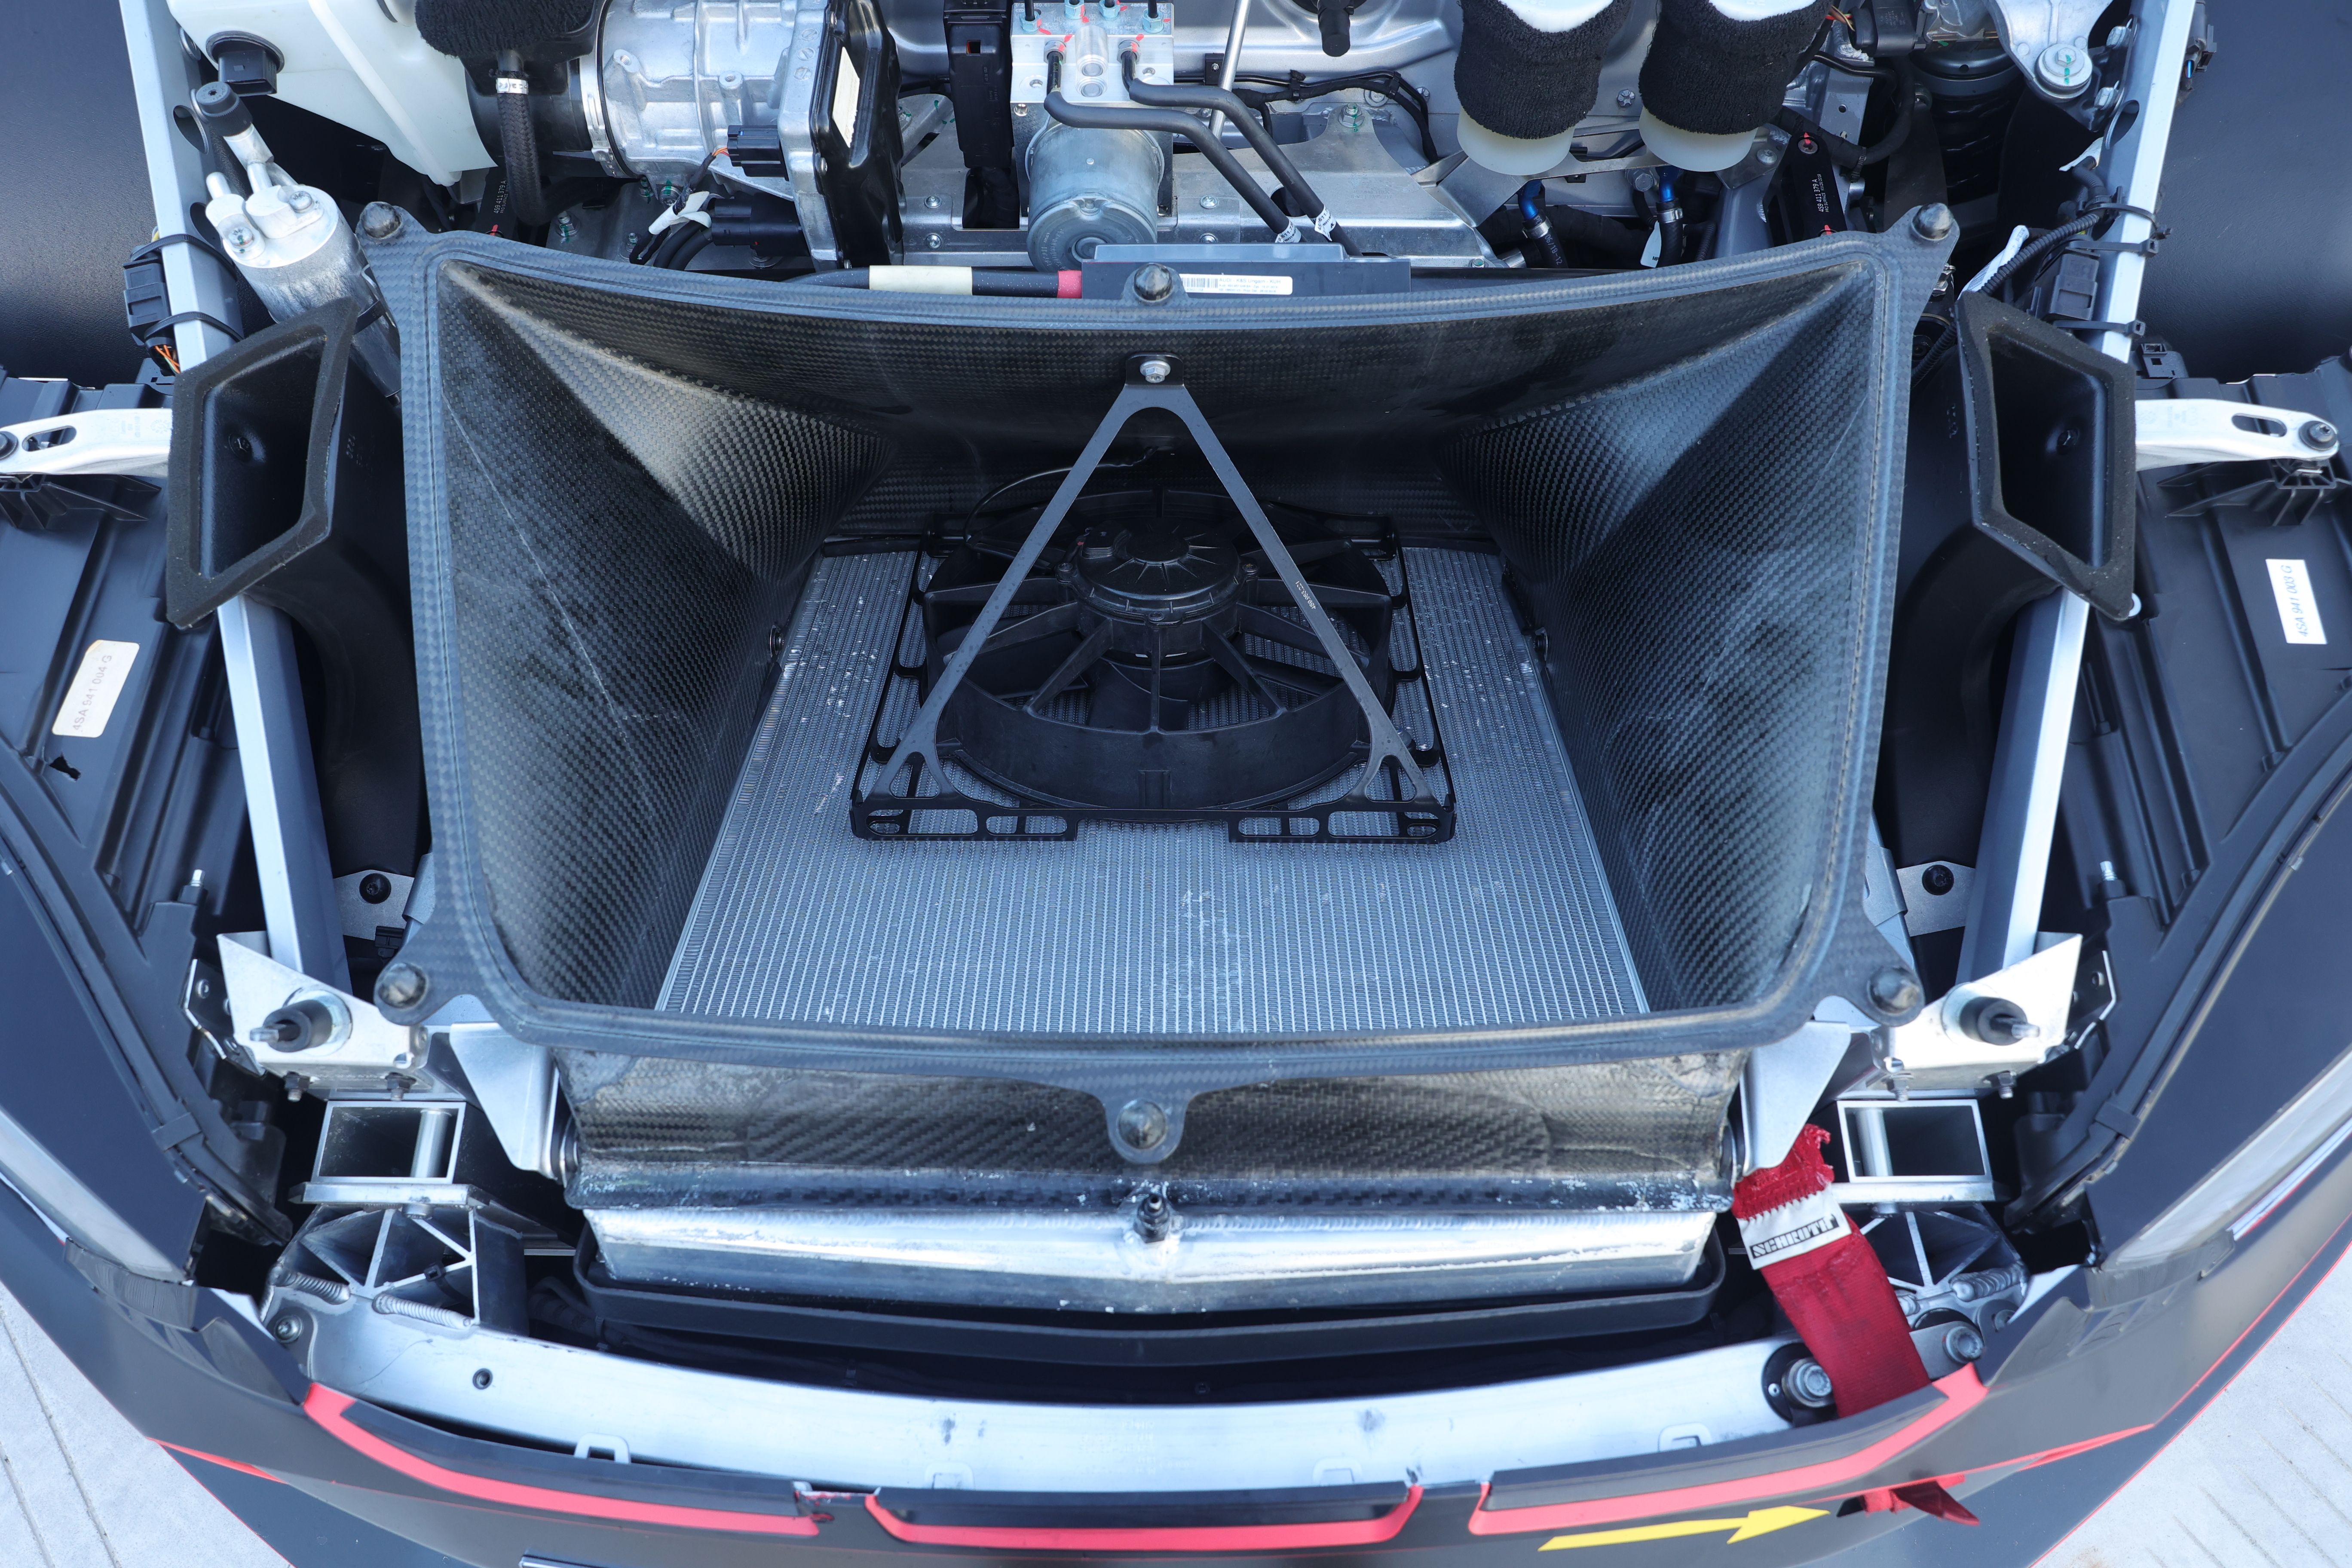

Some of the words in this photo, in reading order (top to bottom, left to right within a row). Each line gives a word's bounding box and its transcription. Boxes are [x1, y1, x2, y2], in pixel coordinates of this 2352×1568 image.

[1545, 234, 1563, 265] 06/18-12
[2280, 565, 2292, 573] G
[2283, 576, 2297, 594] 003
[2289, 597, 2303, 614] 941
[2294, 617, 2308, 637] 4SA
[72, 709, 89, 730] 4SA
[82, 689, 98, 706] 941
[92, 667, 107, 684] 004
[101, 655, 112, 663] G
[1751, 1216, 1837, 1258] SCHROTH
